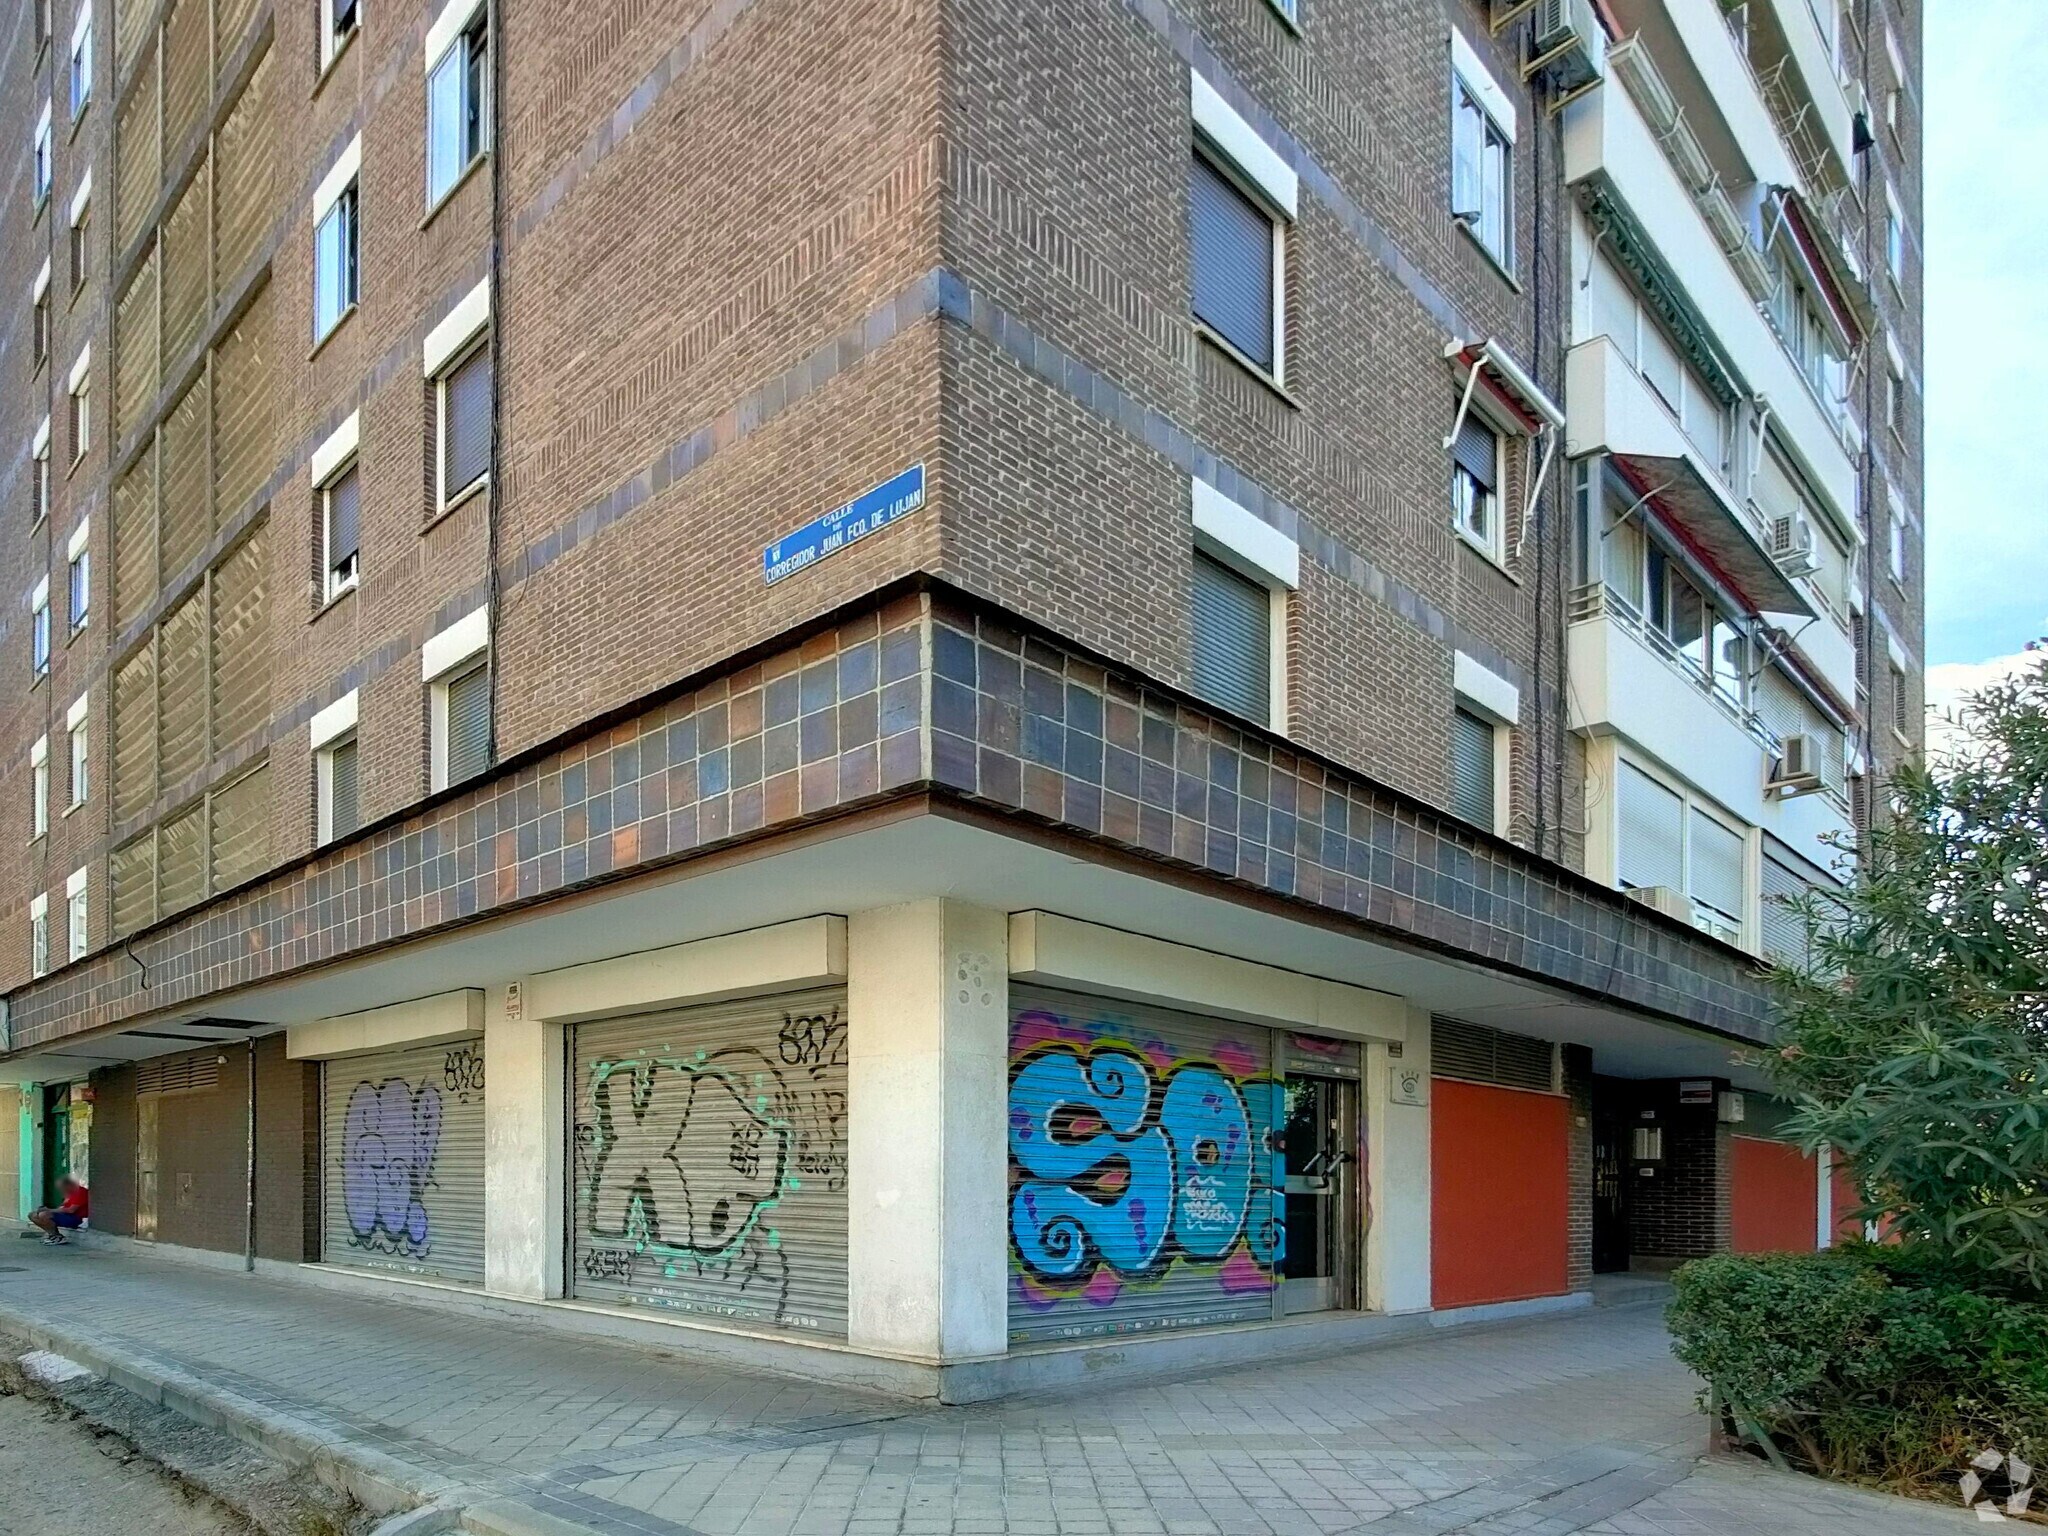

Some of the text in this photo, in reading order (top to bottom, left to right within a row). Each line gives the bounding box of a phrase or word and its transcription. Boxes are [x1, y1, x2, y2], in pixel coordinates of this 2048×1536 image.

[766, 488, 921, 584] CORREGIDOR JUAN FCO. DE LUJAN
[822, 503, 854, 528] CALLE
